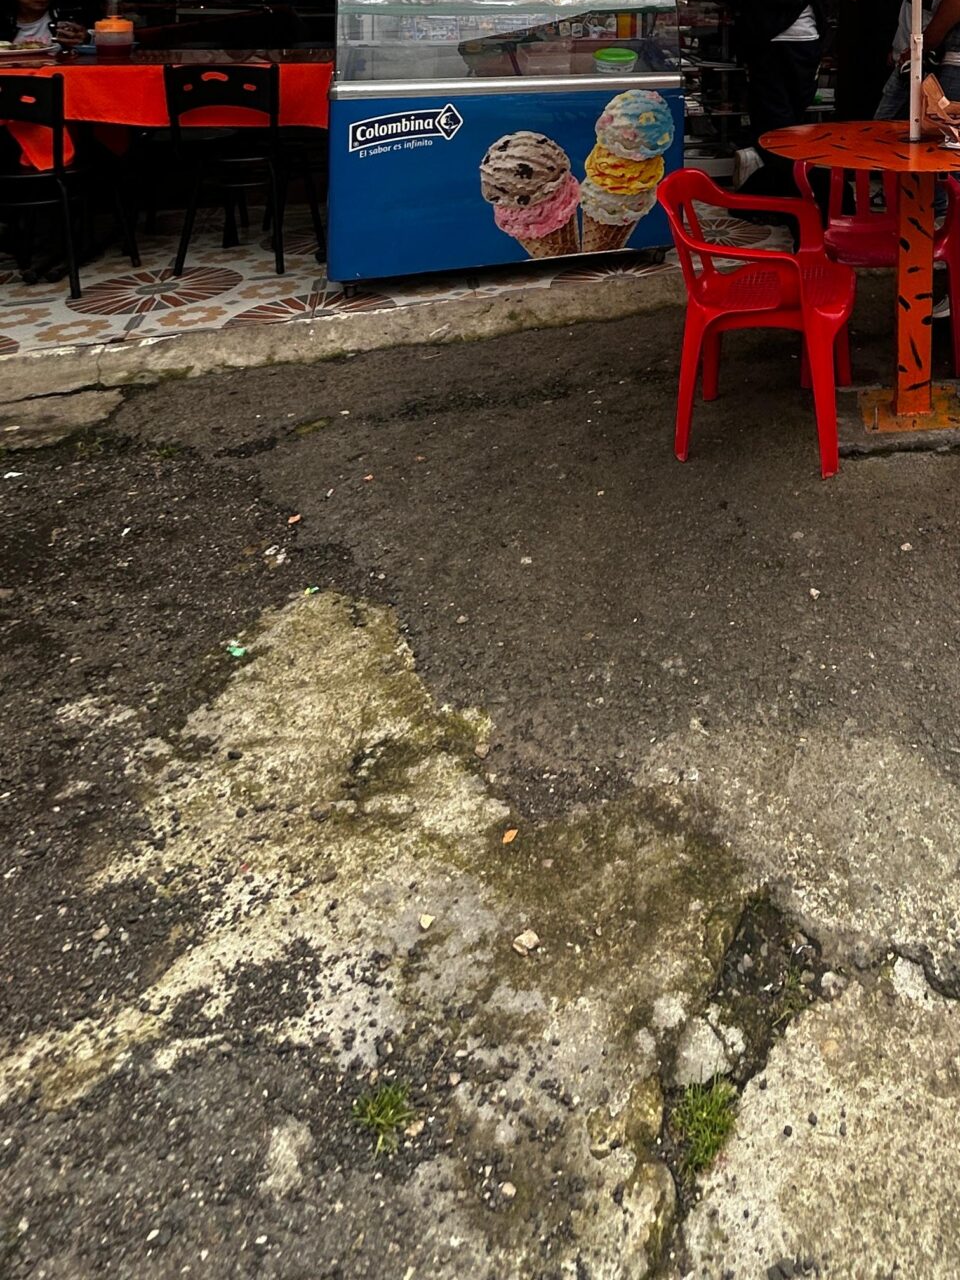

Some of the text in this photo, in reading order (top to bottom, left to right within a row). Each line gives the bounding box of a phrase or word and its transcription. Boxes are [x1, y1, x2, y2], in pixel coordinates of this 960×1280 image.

[356, 116, 433, 141] Colombina
[359, 138, 433, 158] El sabor es infinito
